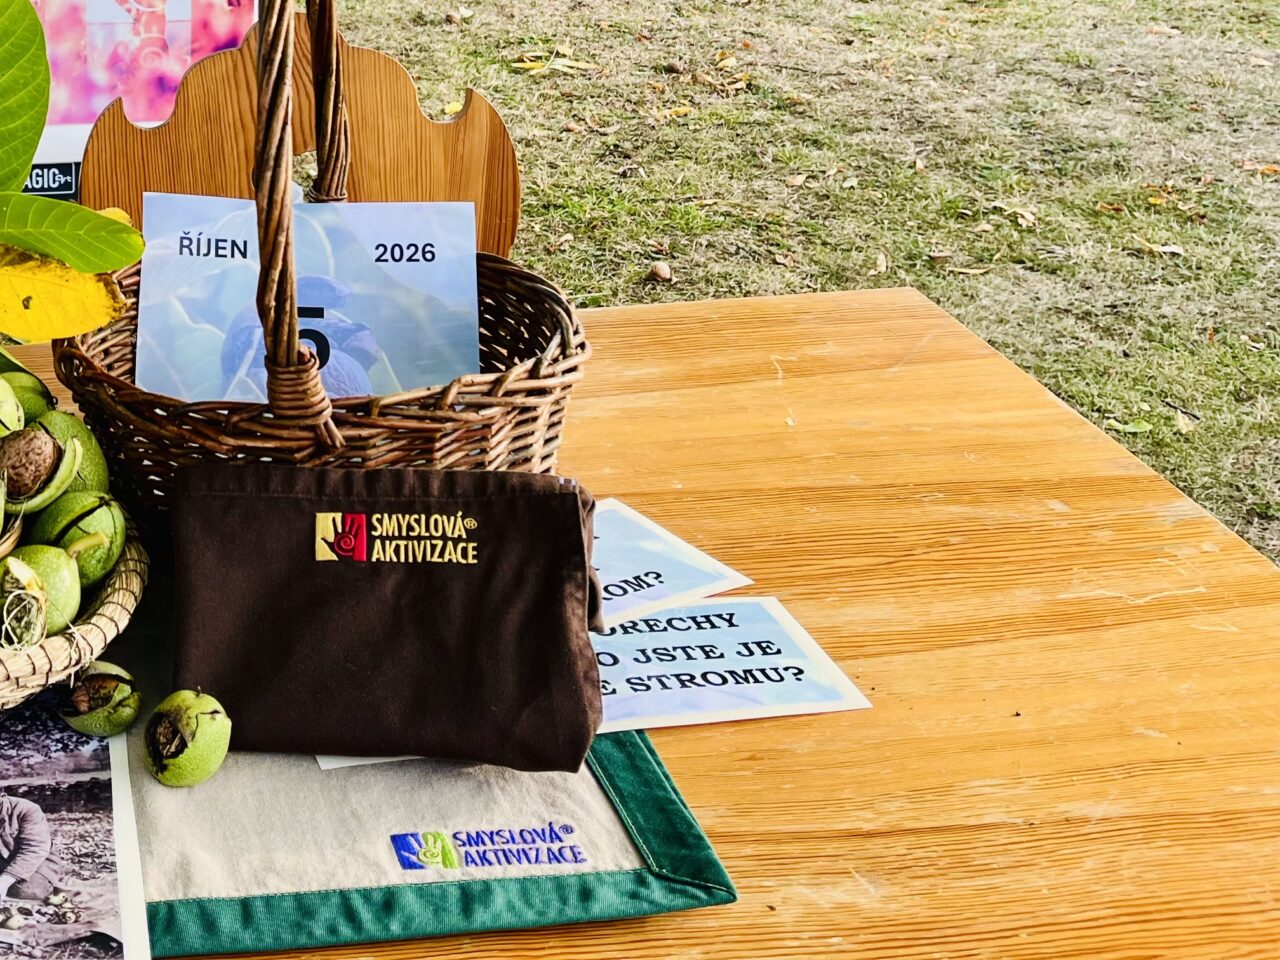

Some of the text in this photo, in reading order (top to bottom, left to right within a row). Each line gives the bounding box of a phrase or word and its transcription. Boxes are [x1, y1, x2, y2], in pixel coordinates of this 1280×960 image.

[178, 231, 436, 263] ŘÍJEN 2026
[371, 539, 478, 564] AKTIVIZACE
[602, 571, 665, 601] OM?
[633, 644, 725, 664] JSTE
[735, 639, 782, 657] JE
[625, 665, 805, 693] STROMU?
[463, 844, 588, 868] AKTIVIZACE
